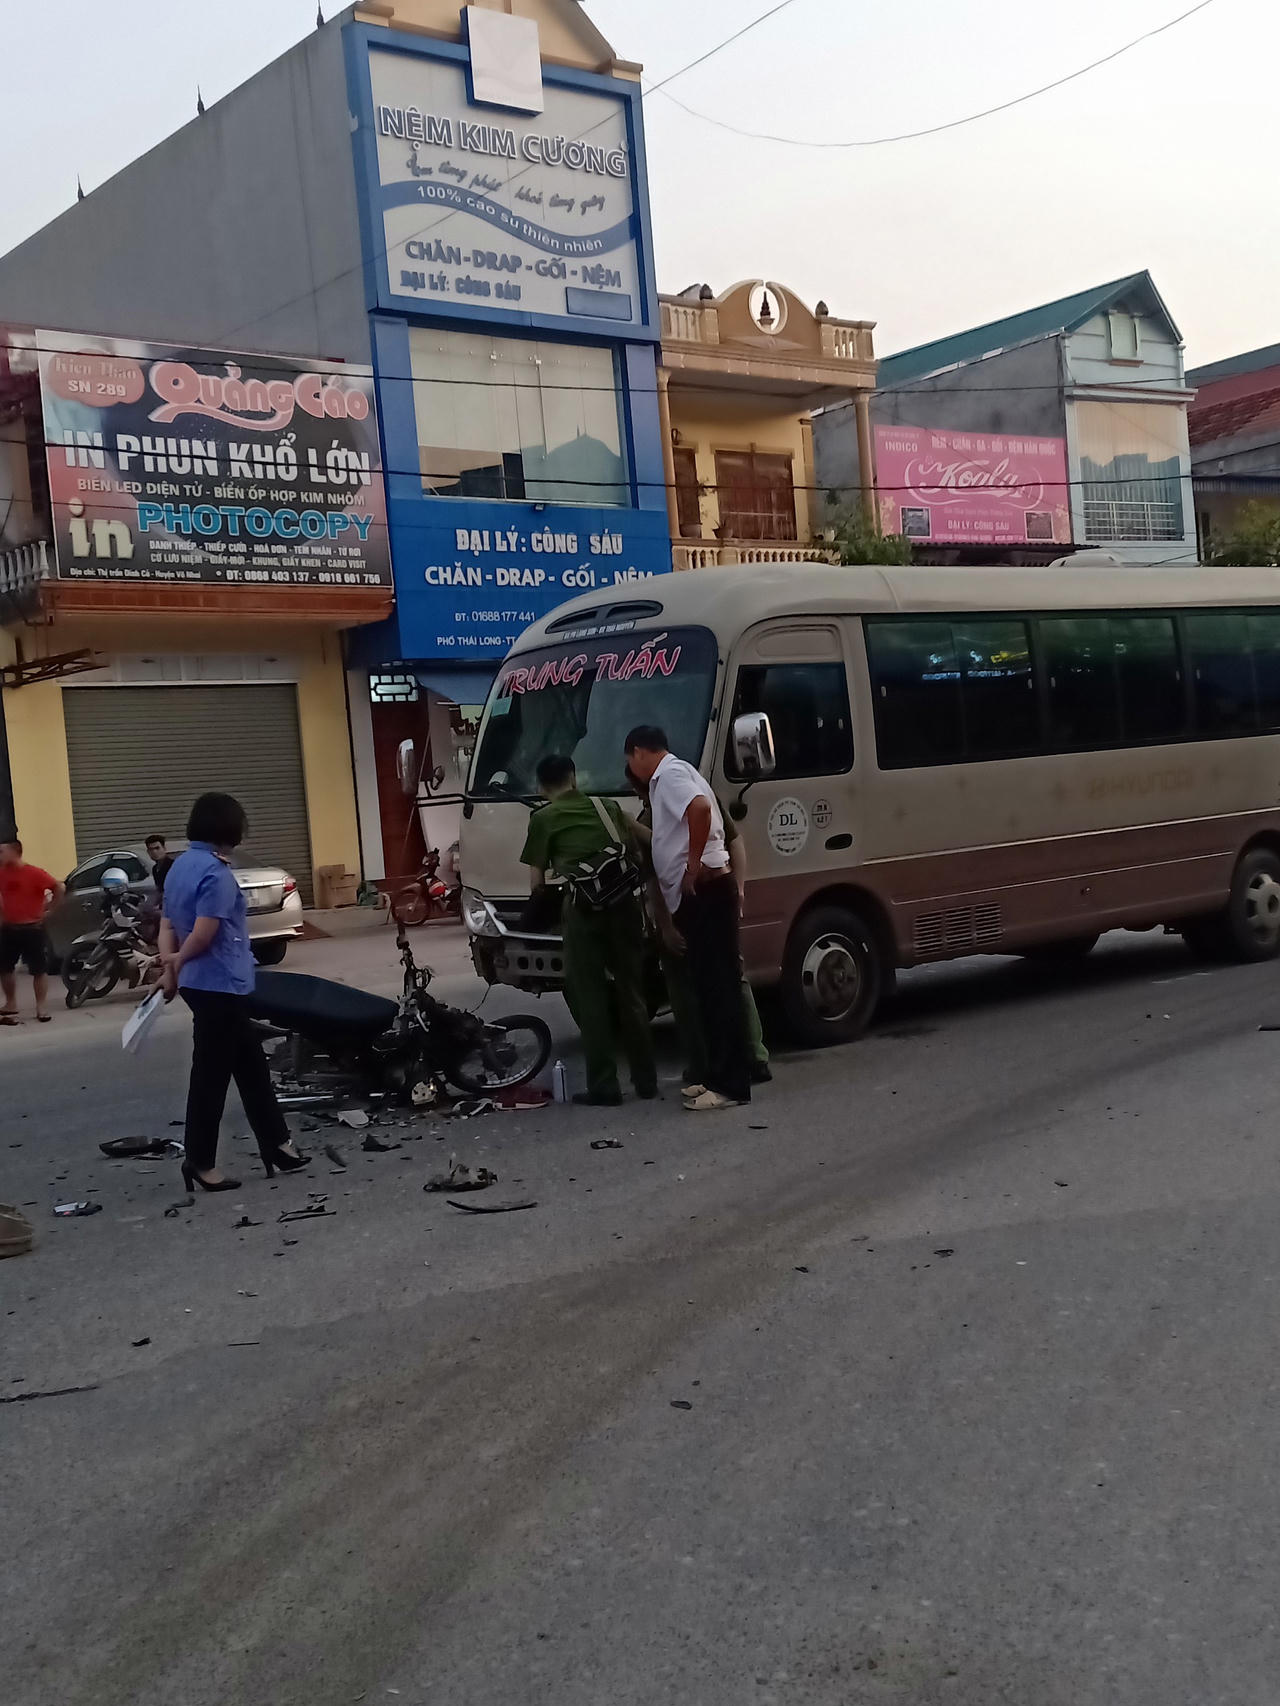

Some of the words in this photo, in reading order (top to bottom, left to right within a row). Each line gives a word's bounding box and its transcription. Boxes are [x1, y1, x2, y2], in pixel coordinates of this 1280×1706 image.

[378, 104, 453, 151] NỆM
[457, 119, 518, 160] KIM
[521, 132, 628, 178] CƯƠNG
[416, 185, 461, 203] 100%
[466, 196, 496, 217] cao
[404, 239, 462, 266] CHĂN
[472, 249, 523, 274] DRAP
[534, 257, 567, 280] GỐI
[68, 379, 91, 393] SN
[97, 383, 127, 397] 289
[148, 360, 296, 432] Quảng
[295, 372, 369, 421] Cáo
[63, 430, 105, 469] IN
[116, 434, 219, 477] PHUN
[228, 432, 298, 482] KHỔ
[307, 440, 373, 486] LỚN
[115, 481, 143, 494] LED
[145, 481, 180, 499] ĐIỆN
[270, 491, 297, 505] HỢP
[300, 492, 325, 505] KIM
[68, 497, 135, 559] in
[137, 501, 374, 541] PHOTOCOPY
[456, 528, 490, 556] ĐẠI
[531, 526, 578, 554] CÔNG
[590, 529, 623, 555] SÁU
[292, 571, 311, 582] 137
[425, 561, 482, 587] CHĂN
[496, 567, 546, 587] DRAP
[562, 562, 596, 588] GỐI
[471, 610, 500, 622] 01688
[501, 611, 518, 622] 177
[518, 611, 536, 622] 441
[457, 635, 478, 646] THÁI
[479, 636, 502, 646] LONG
[501, 653, 587, 697] TRUNG
[595, 632, 681, 682] TUẤN
[779, 813, 798, 826] DL
